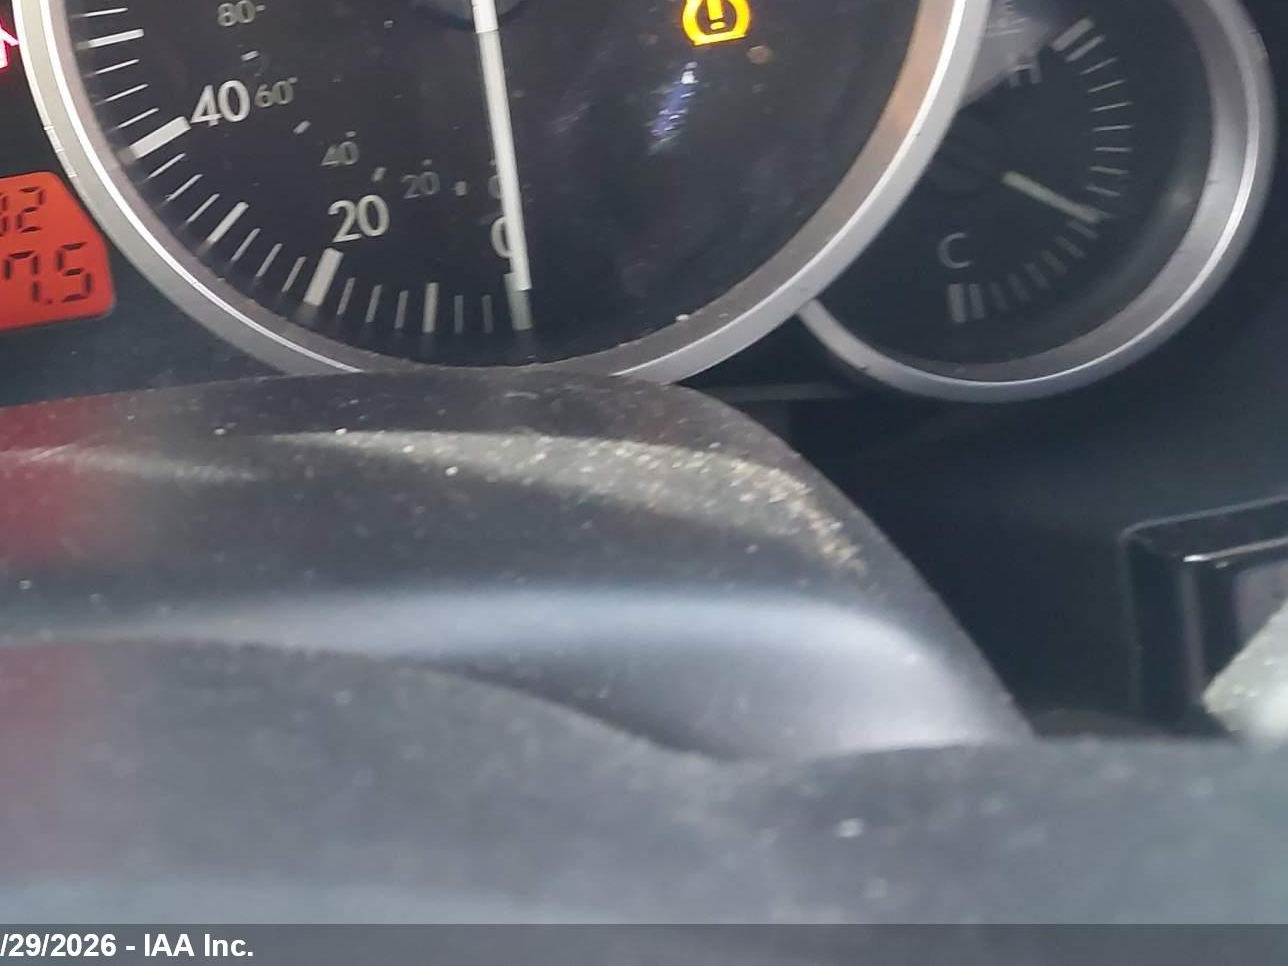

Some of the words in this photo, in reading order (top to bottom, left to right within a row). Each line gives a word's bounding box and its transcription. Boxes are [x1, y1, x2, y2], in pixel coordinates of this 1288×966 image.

[217, 0, 257, 27] 80
[190, 80, 251, 127] 40
[254, 81, 295, 108] 60
[320, 141, 360, 168] 40
[400, 171, 441, 199] 20
[328, 194, 390, 243] 20
[937, 232, 972, 269] C
